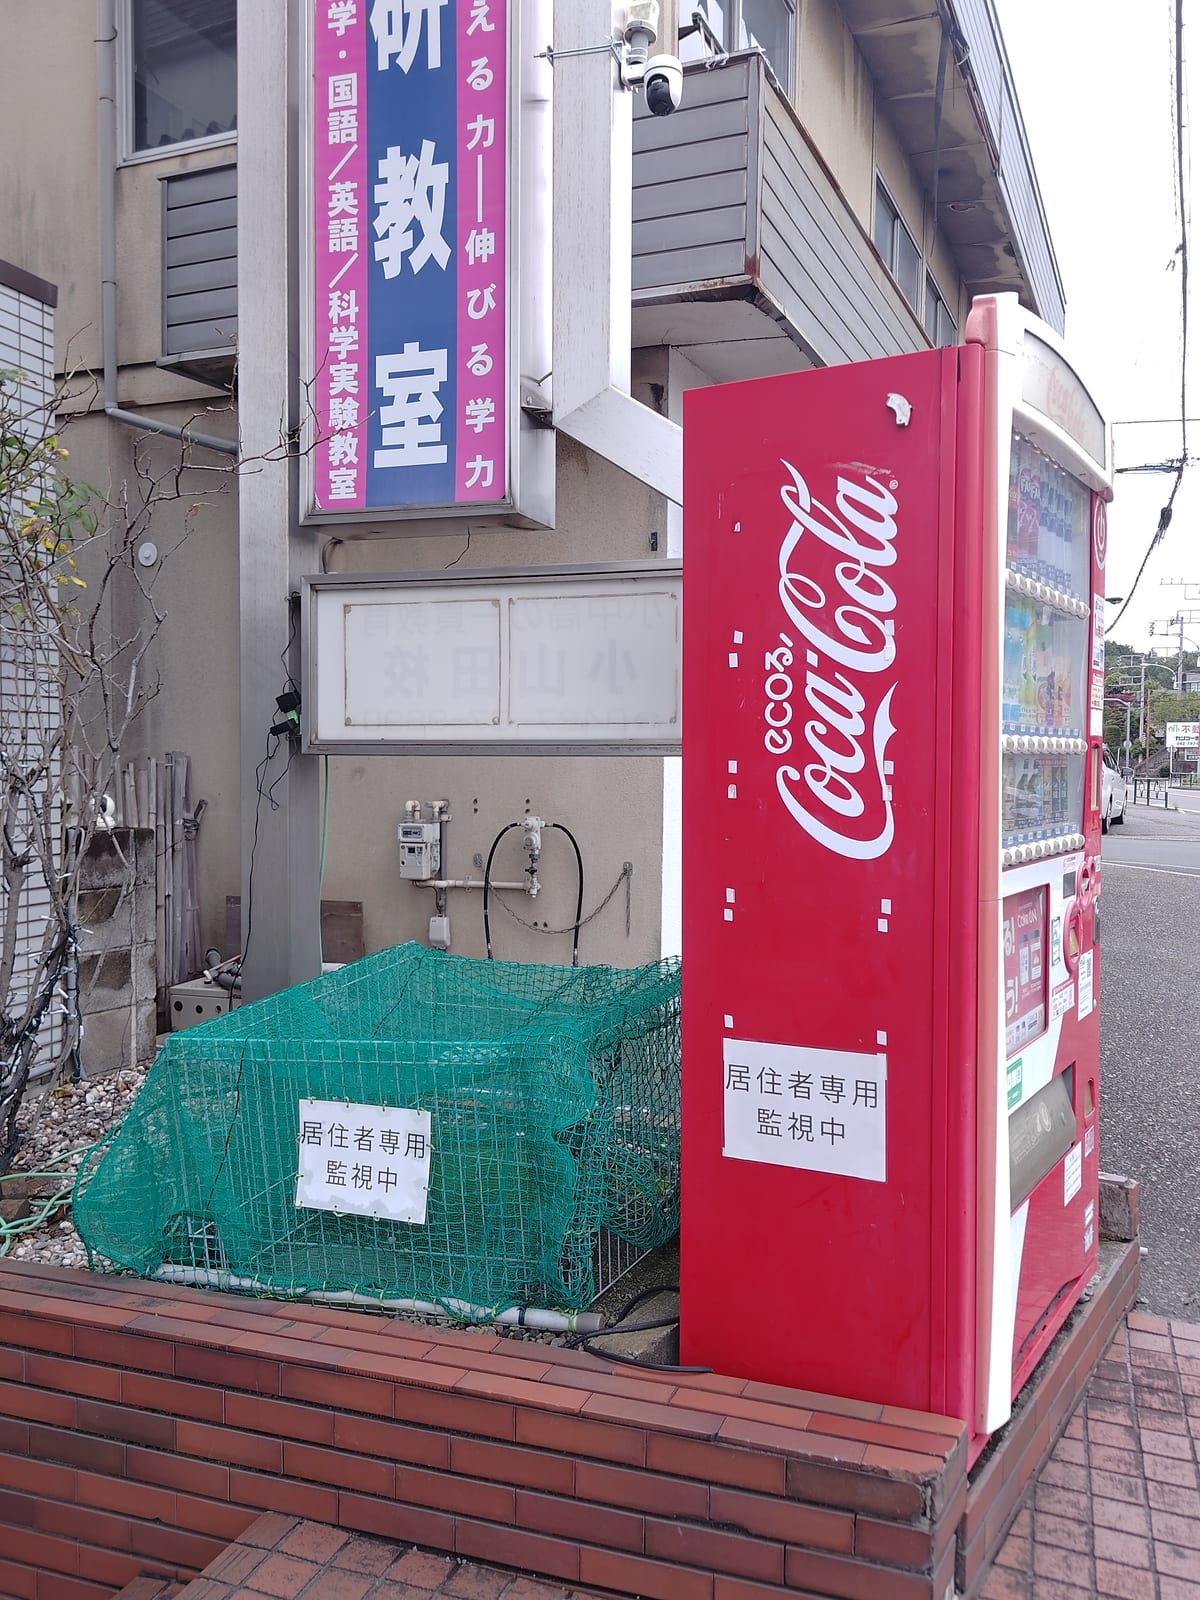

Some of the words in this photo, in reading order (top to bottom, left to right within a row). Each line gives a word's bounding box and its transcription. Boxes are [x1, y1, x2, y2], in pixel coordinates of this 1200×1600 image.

[776, 458, 899, 861] Coca-Cola
[725, 1063, 878, 1109] 居住者専用
[301, 1121, 425, 1159] 居住者専用
[756, 1107, 845, 1145] 監視中
[325, 1159, 398, 1193] 監視中
